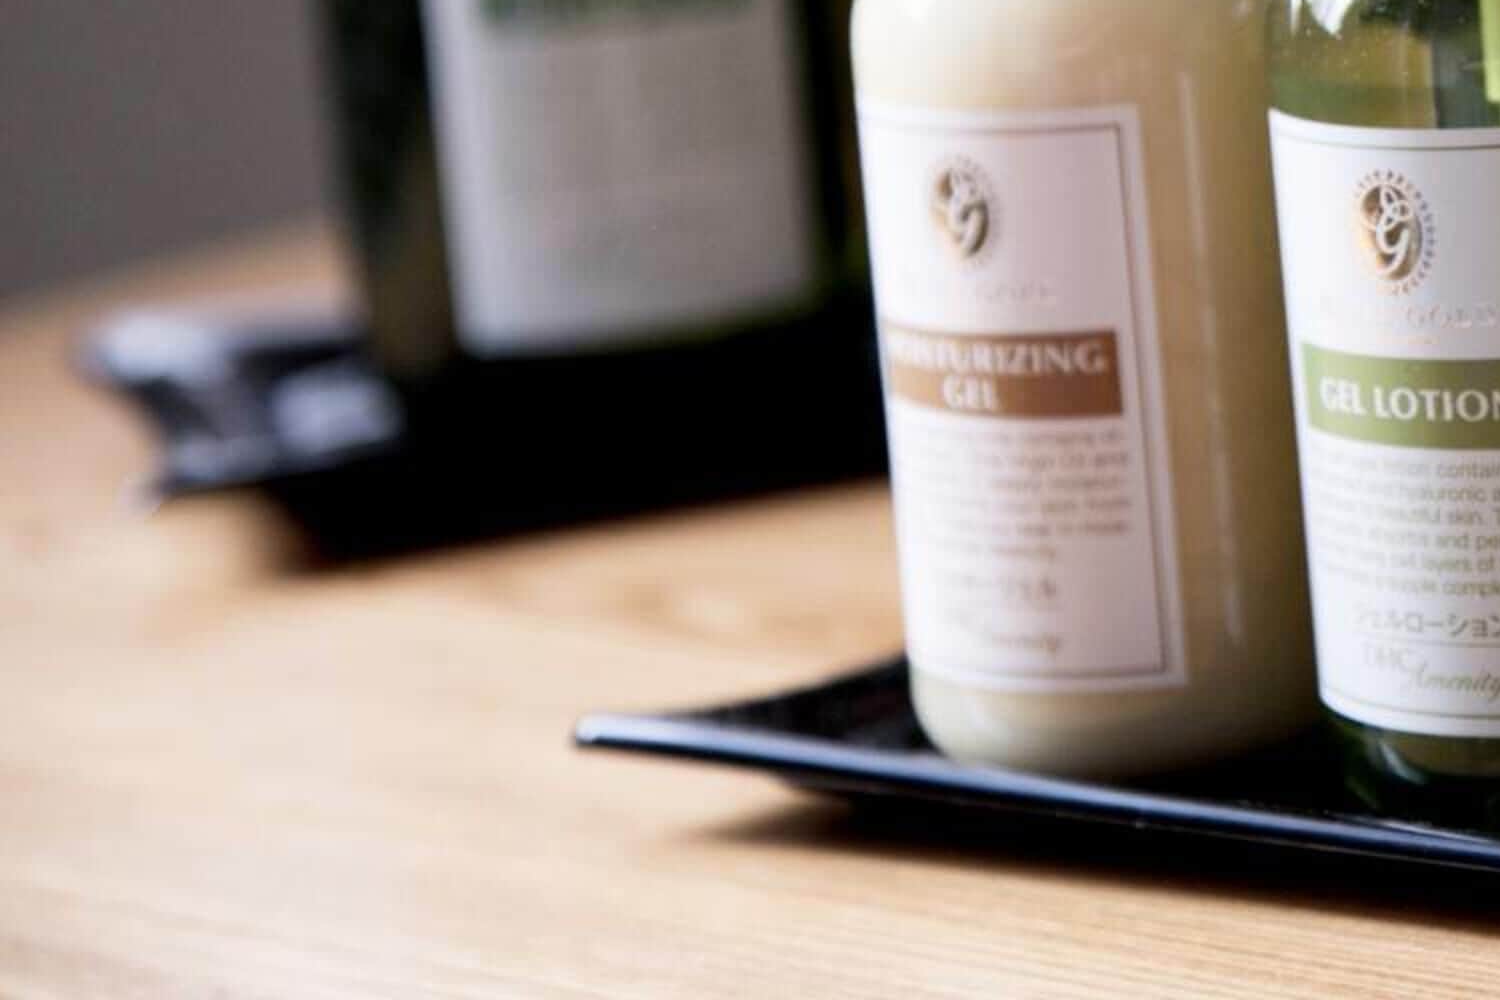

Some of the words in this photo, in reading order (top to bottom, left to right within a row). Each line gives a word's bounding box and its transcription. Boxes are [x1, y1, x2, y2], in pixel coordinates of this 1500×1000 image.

[888, 334, 1108, 375] ISTURIZING
[943, 376, 1000, 412] GEL
[1319, 377, 1367, 415] GEL
[1435, 531, 1469, 550] and
